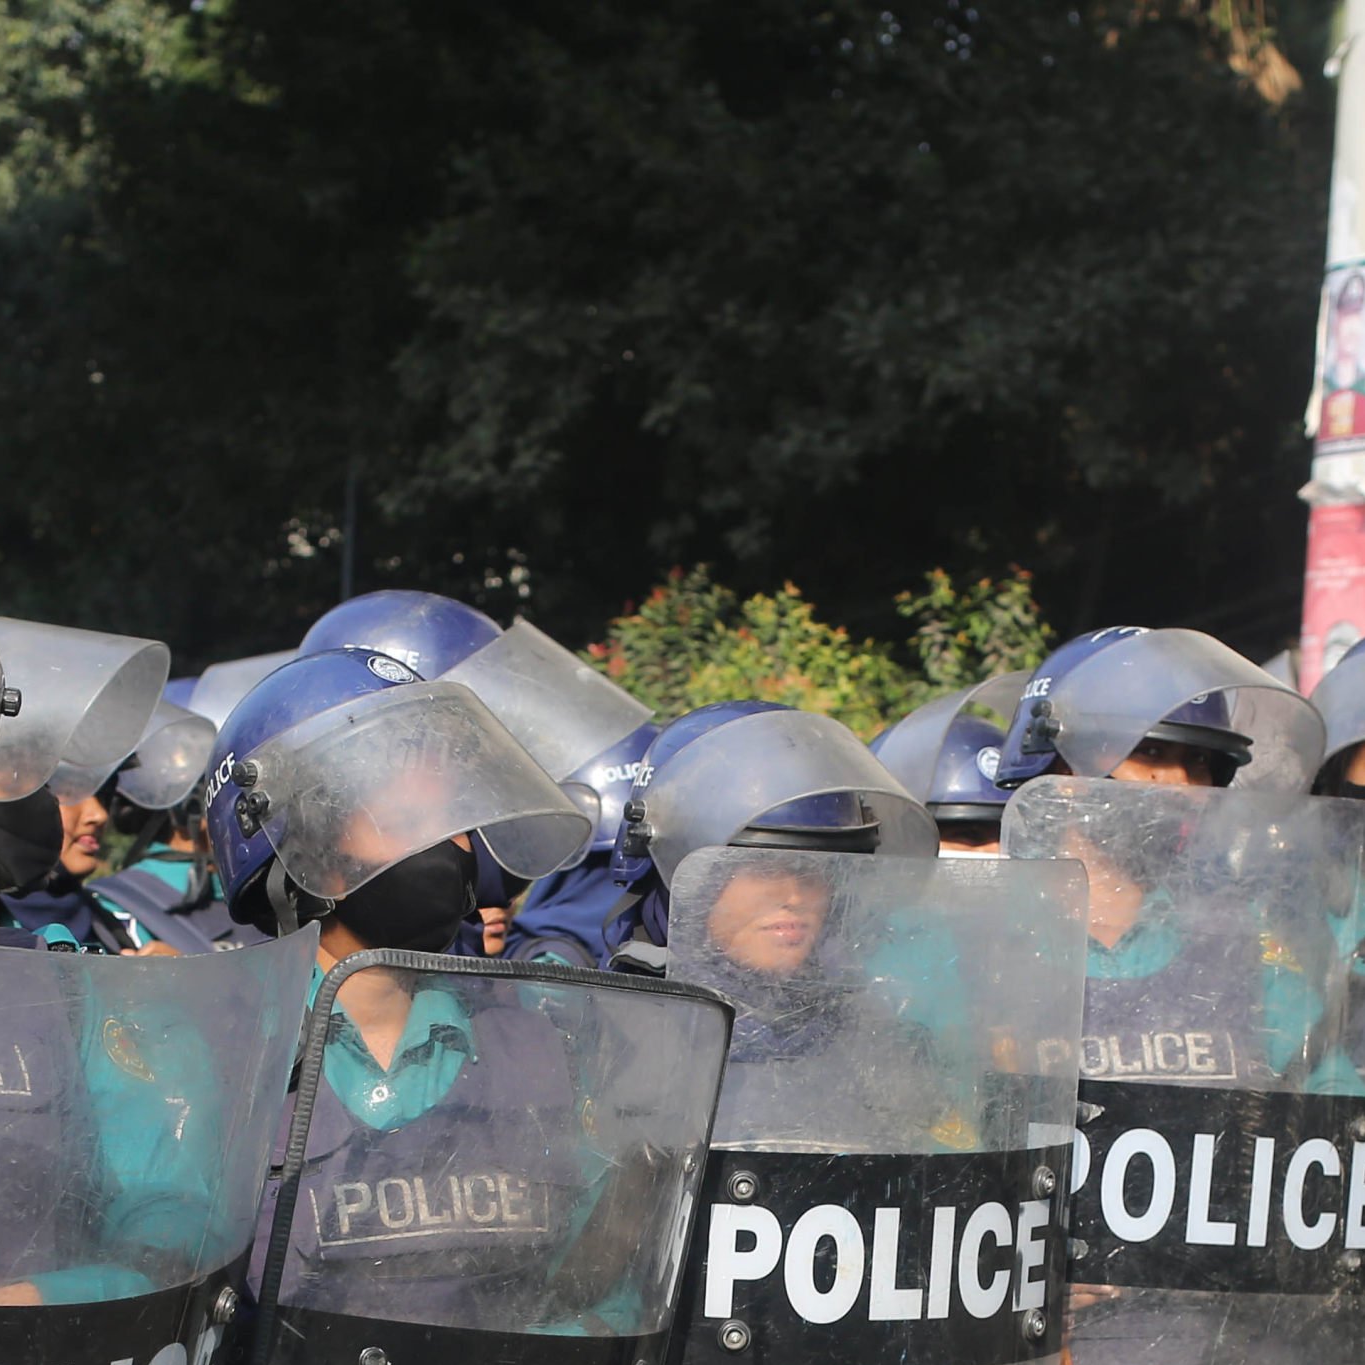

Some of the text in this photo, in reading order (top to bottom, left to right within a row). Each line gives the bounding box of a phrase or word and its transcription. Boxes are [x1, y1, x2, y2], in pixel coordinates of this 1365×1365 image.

[205, 751, 235, 812] OLICE
[335, 1173, 533, 1235] POLICE
[704, 1199, 1051, 1324] POLICE
